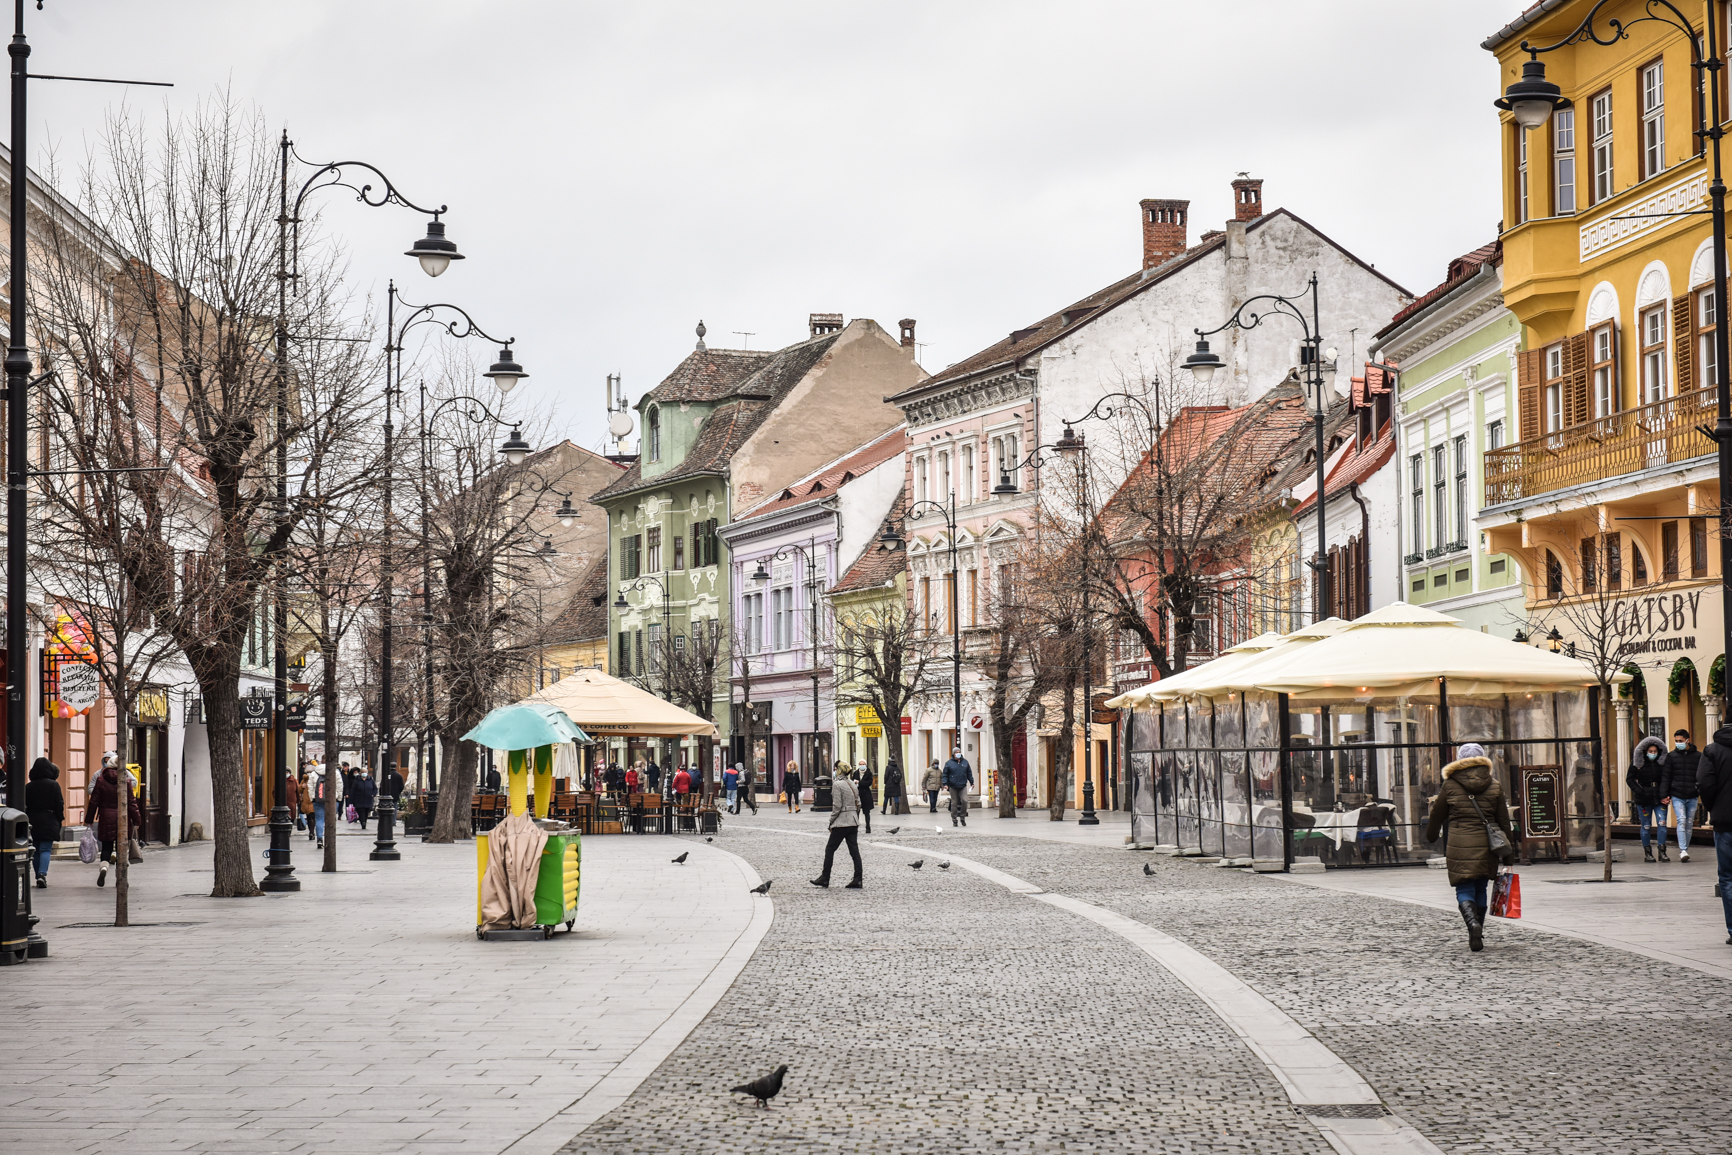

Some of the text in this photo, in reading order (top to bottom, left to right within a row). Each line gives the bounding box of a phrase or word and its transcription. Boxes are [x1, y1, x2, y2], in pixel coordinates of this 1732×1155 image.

[1613, 591, 1700, 637] GATSBY
[1657, 637, 1684, 652] COCKTAIL
[1684, 636, 1697, 649] BAR
